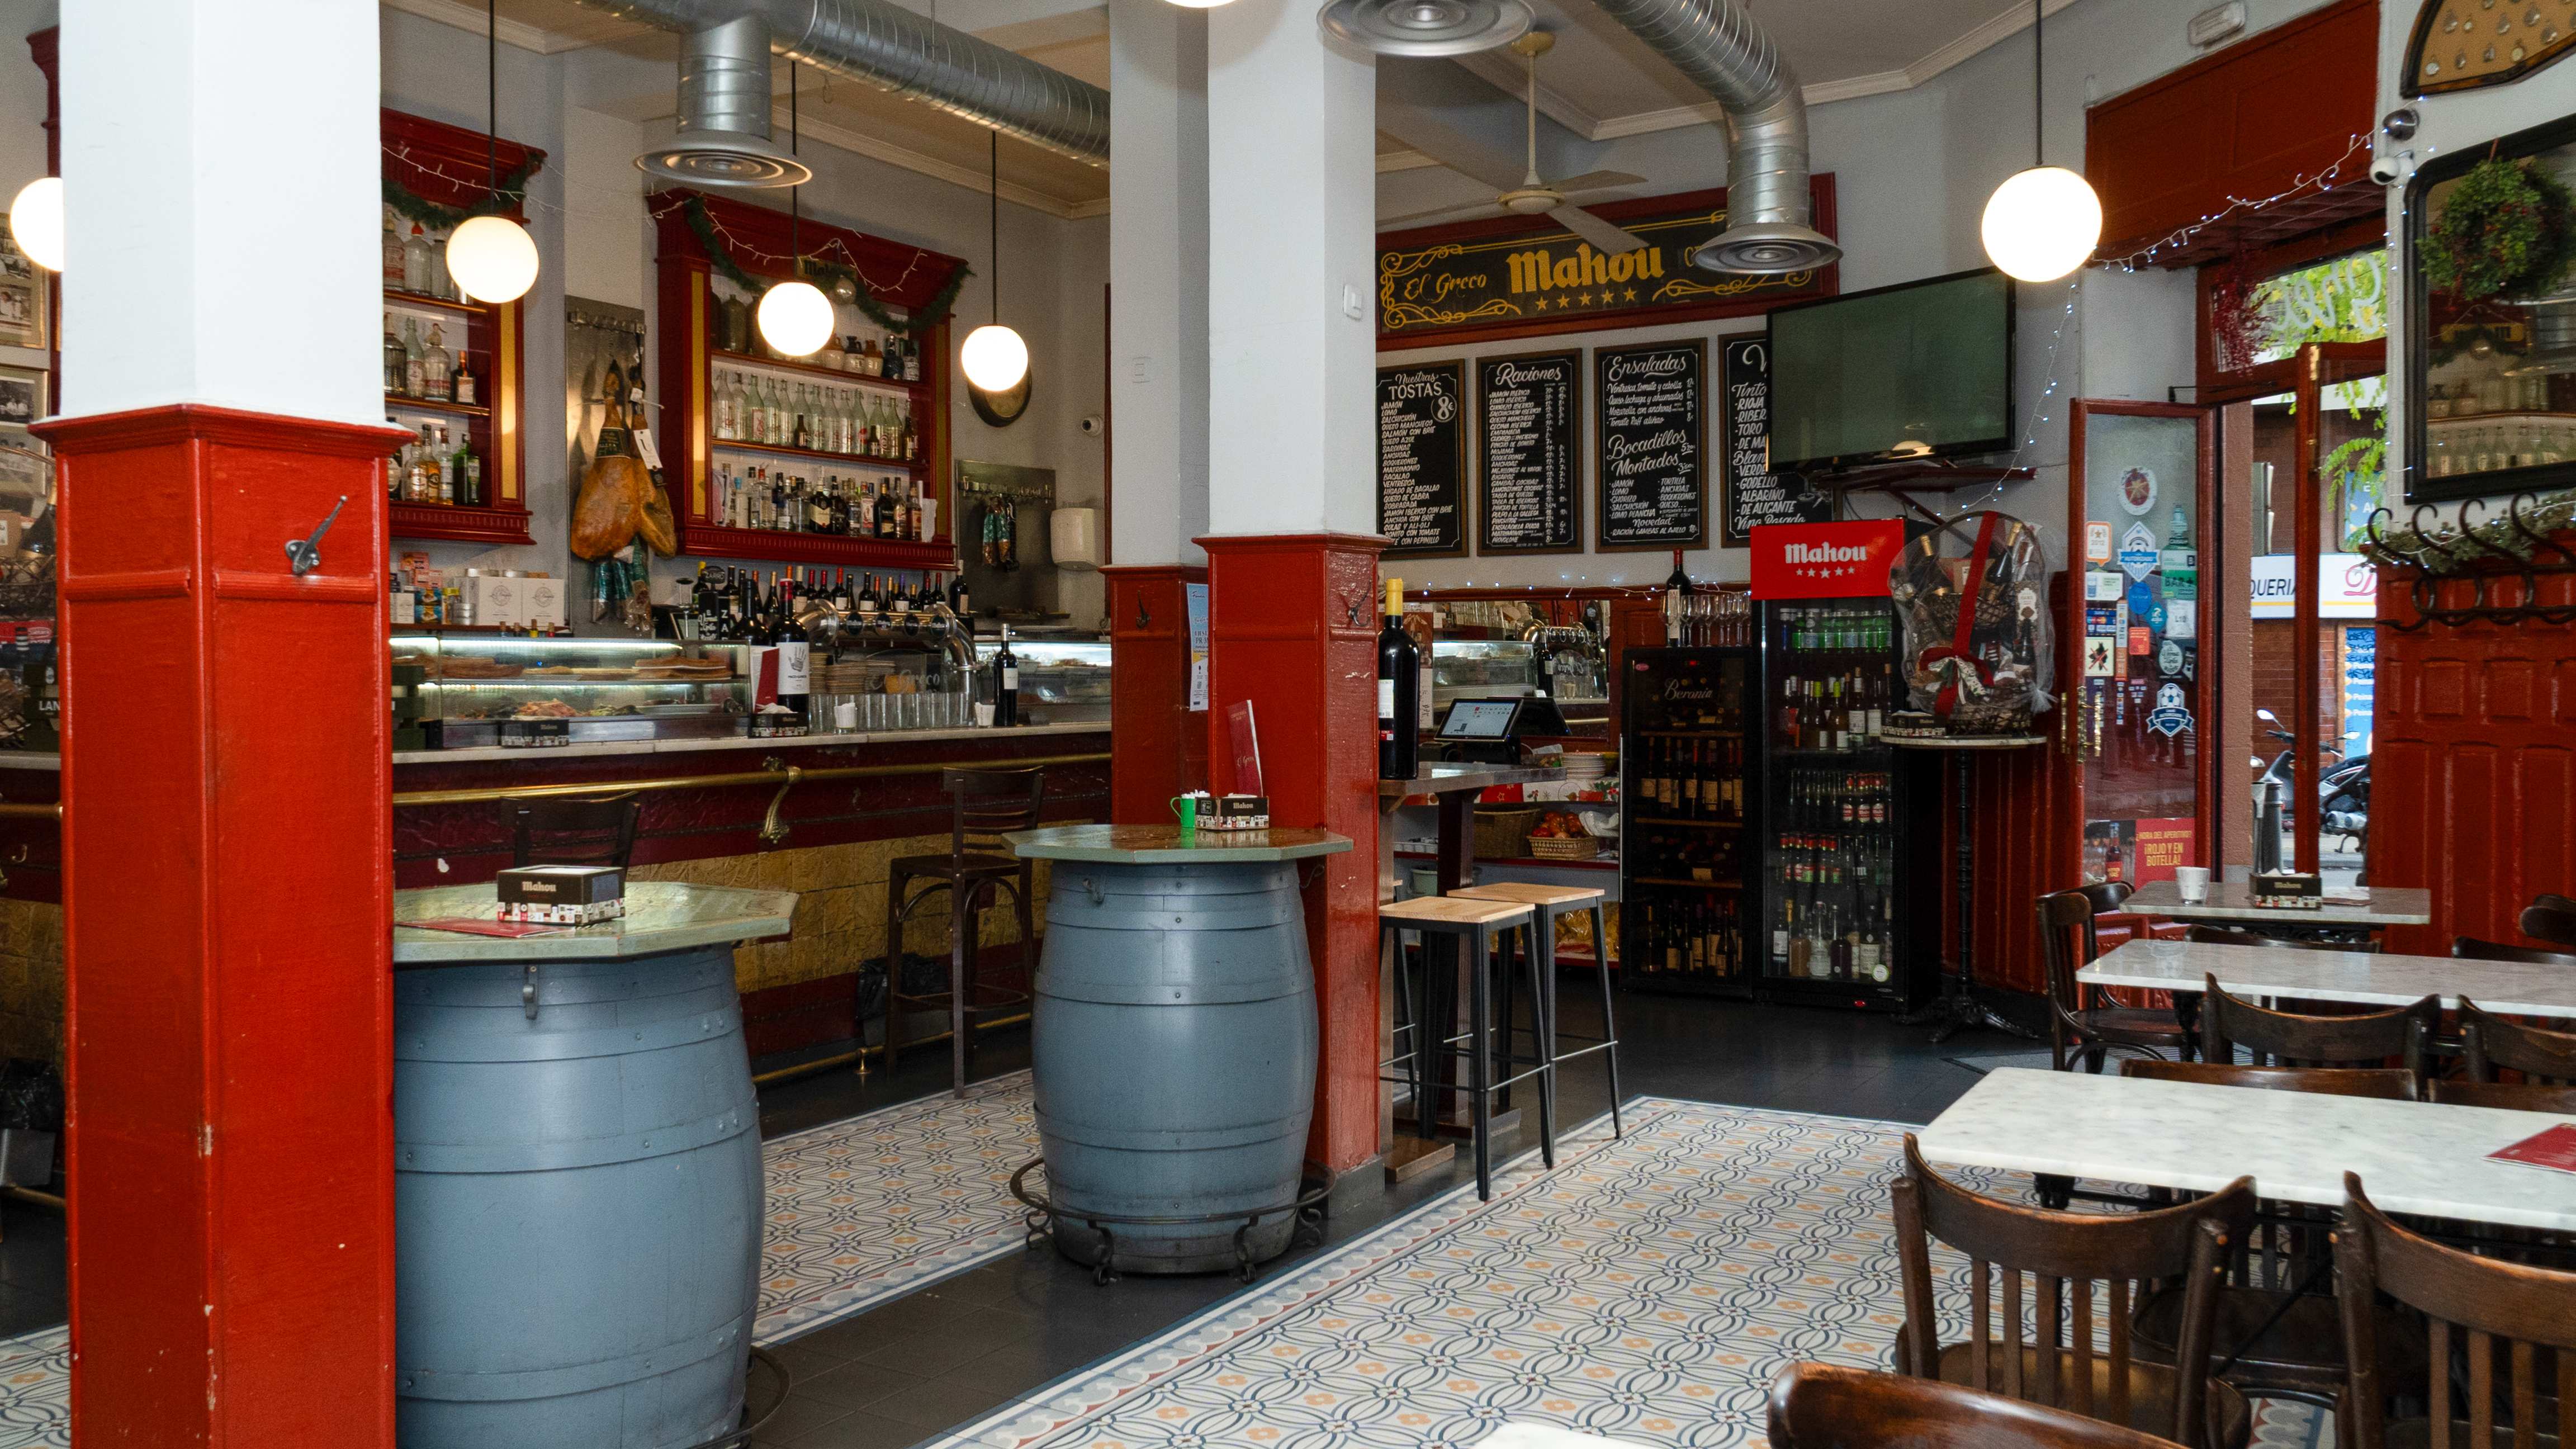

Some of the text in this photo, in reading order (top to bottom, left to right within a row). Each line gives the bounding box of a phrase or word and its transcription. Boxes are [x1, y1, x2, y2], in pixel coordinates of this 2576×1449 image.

[1506, 243, 1667, 293] Mahou
[1404, 272, 1487, 303] El Greco
[1608, 354, 1687, 381] Ensaladas
[1395, 371, 1438, 384] Nuestras
[1495, 363, 1561, 388] Raciones
[1388, 381, 1442, 400] TOSTAS
[1381, 401, 1403, 409] JAMÓN
[1646, 396, 1651, 405] y
[1737, 396, 1764, 411] RIOJA
[1637, 406, 1646, 415] con
[1381, 413, 1417, 424] SALCHICHÓN
[1400, 420, 1433, 428] MANCHEGO
[1609, 417, 1629, 427] Tomate
[1423, 426, 1436, 434] BRIE
[1738, 423, 1763, 437] TORO
[1382, 444, 1410, 453] SARDINAS
[1607, 429, 1686, 460] Bocadillos
[1738, 437, 1751, 450] DE
[1382, 457, 1418, 466] BOQUERONES
[1611, 451, 1678, 476] Montados
[1383, 465, 1420, 473] MATRIMONIO
[1383, 479, 1415, 487] VENTRESCA
[1612, 479, 1634, 488] JAMÓN
[1661, 477, 1685, 485] TORTILLA
[1740, 476, 1778, 490] GODELLO
[1612, 487, 1629, 496] LOMO
[1660, 492, 1697, 501] BOQUERONES
[1740, 487, 1786, 503] ALBARIÑO
[1611, 495, 1637, 503] CHORIZO
[1384, 501, 1417, 510] SOBRASADA
[1439, 505, 1453, 513] BRIE
[1611, 501, 1649, 511] SALCHICHÓN
[1741, 500, 1797, 515] DE ALICANTE
[1612, 509, 1656, 519] LOMO PLANCHA
[1632, 517, 1675, 528] Novedad:
[1784, 541, 1868, 564] Mahou
[1665, 678, 1713, 700] Beronia
[38, 700, 61, 712] LAN
[2144, 842, 2184, 855] ¡ROJO Y EN
[2146, 855, 2181, 866] BOTELLA!
[521, 881, 557, 892] Mahou
